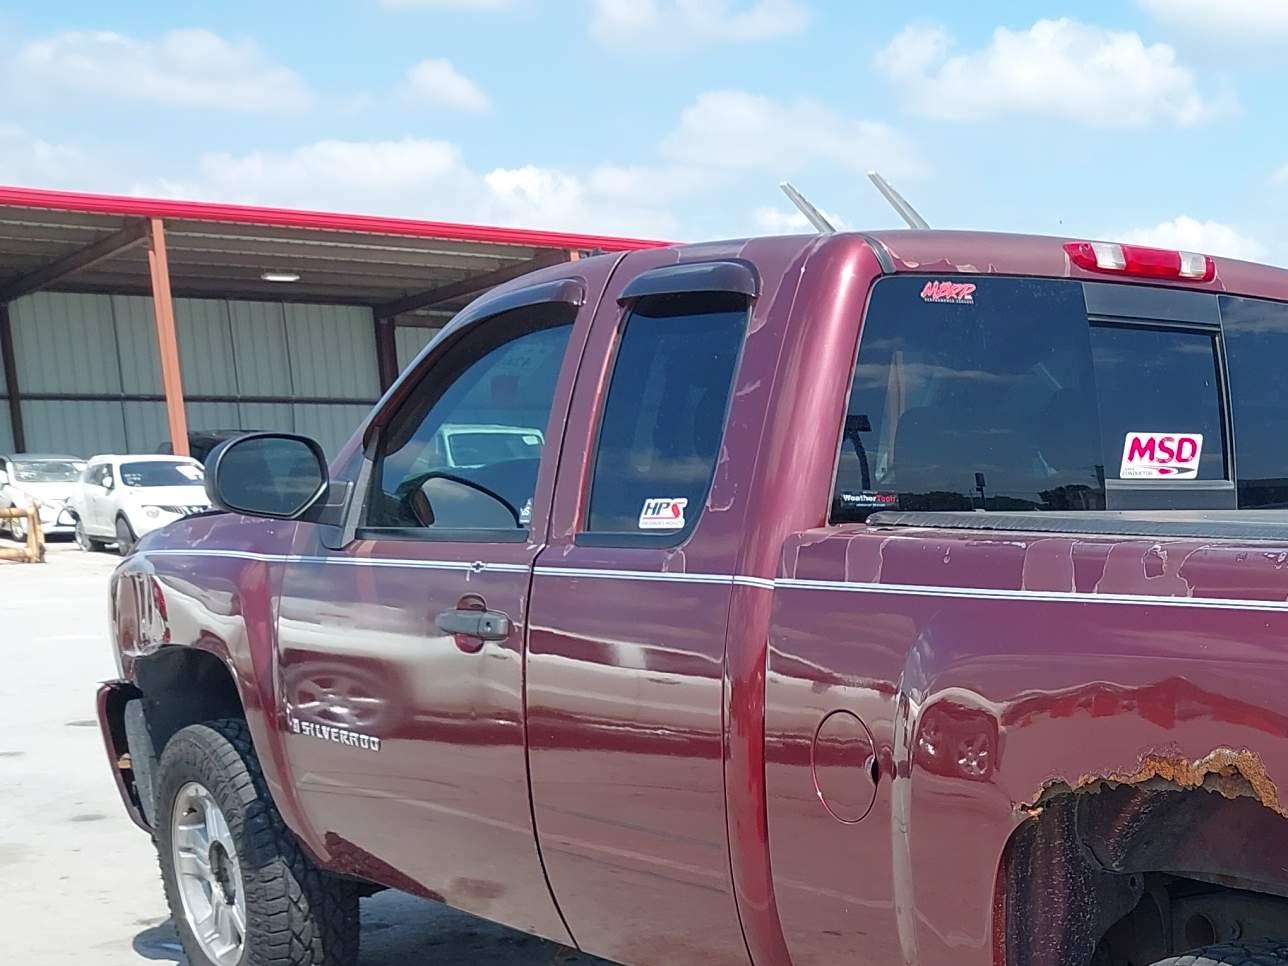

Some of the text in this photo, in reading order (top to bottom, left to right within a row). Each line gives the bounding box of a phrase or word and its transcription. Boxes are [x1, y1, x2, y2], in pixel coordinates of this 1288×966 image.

[1128, 436, 1198, 464] MSD
[643, 501, 686, 519] HPS
[301, 720, 381, 752] SILVERADO
